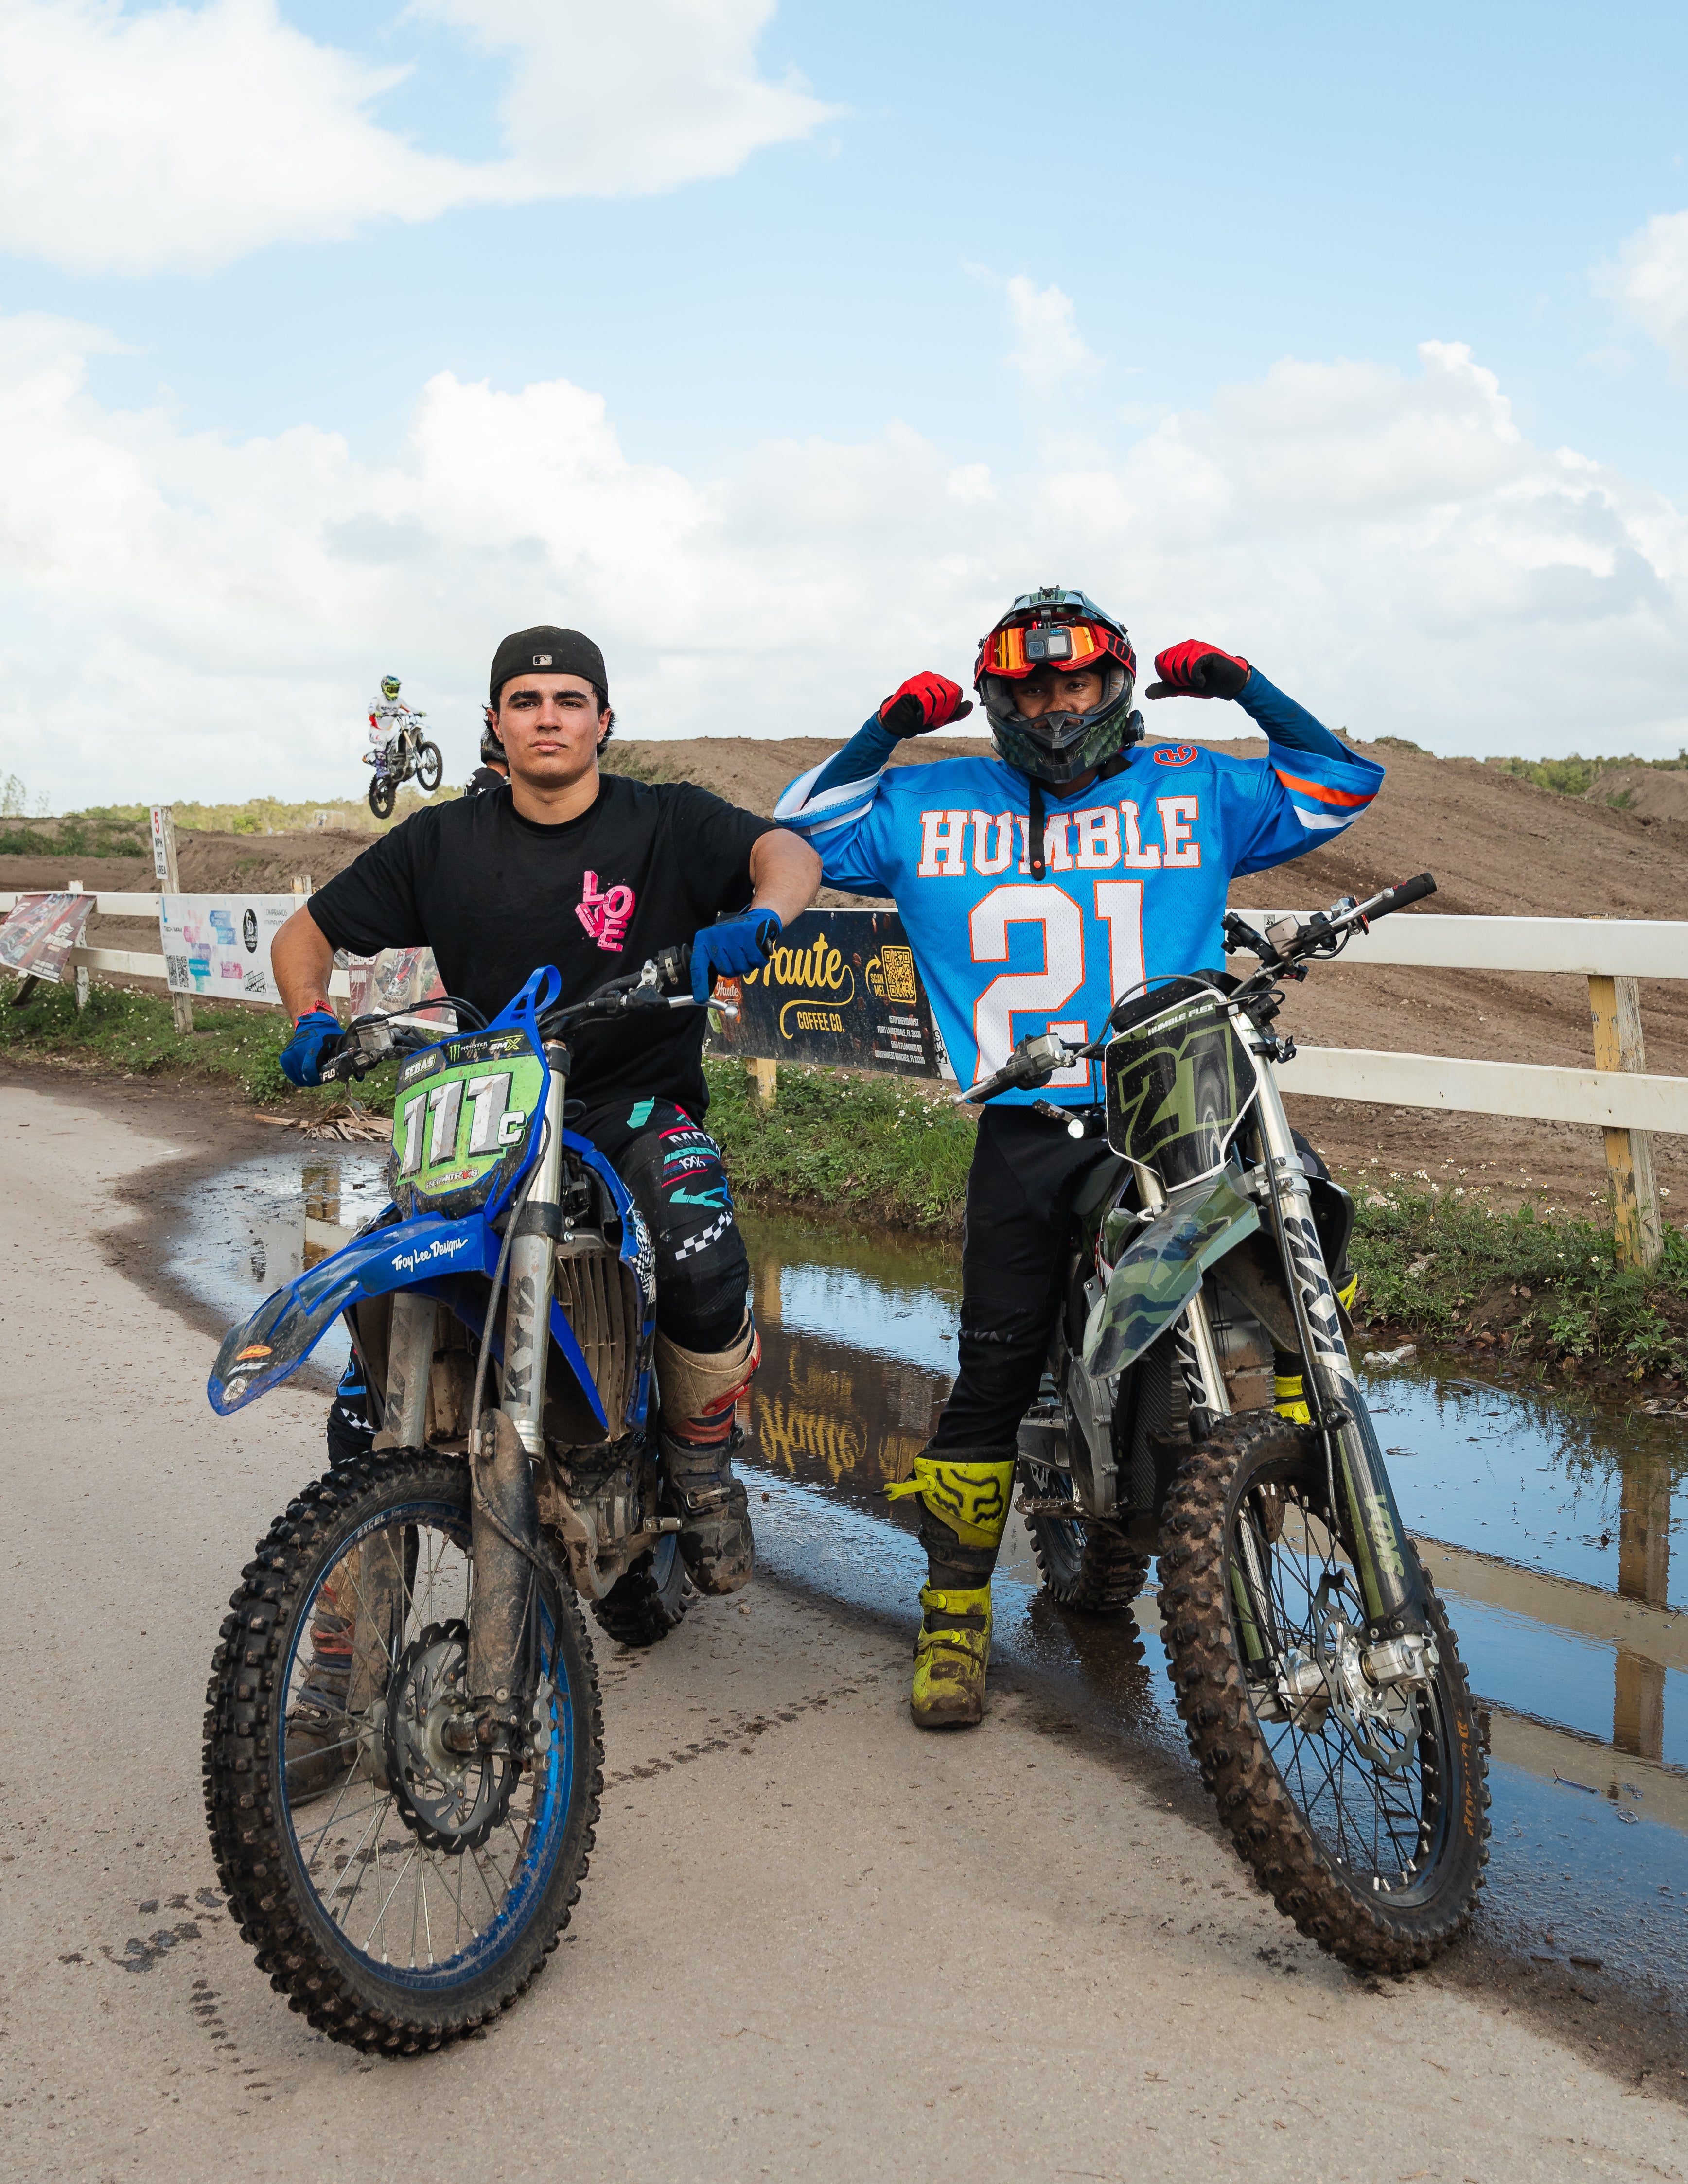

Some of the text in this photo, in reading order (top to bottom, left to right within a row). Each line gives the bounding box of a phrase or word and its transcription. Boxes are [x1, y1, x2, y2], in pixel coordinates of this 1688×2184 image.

[154, 812, 159, 834] 5
[155, 838, 163, 848] MPH
[917, 796, 1201, 877] HUMBLE
[157, 864, 167, 875] AREA
[264, 909, 288, 917] OMPRAMOS
[870, 973, 884, 984] SCAN
[969, 879, 1146, 1088] 21
[715, 981, 740, 997] Haute
[874, 985, 885, 997] ME!
[797, 1011, 845, 1032] COFFEE CO.
[914, 1018, 919, 1027] ST
[1147, 1003, 1214, 1036] HUMBLE FLEX
[907, 1029, 911, 1037] FL
[461, 1042, 488, 1051] MONSTER
[490, 1037, 522, 1052] SMX
[874, 1049, 895, 1060] SOUTHWEST
[322, 1068, 335, 1082] FLO
[404, 1054, 436, 1081] SEBAS
[1118, 1023, 1237, 1166] 21
[391, 1238, 469, 1273] Troy Lee Designs
[357, 1514, 387, 1540] EXCEL
[1457, 1720, 1477, 1836] DULOP
